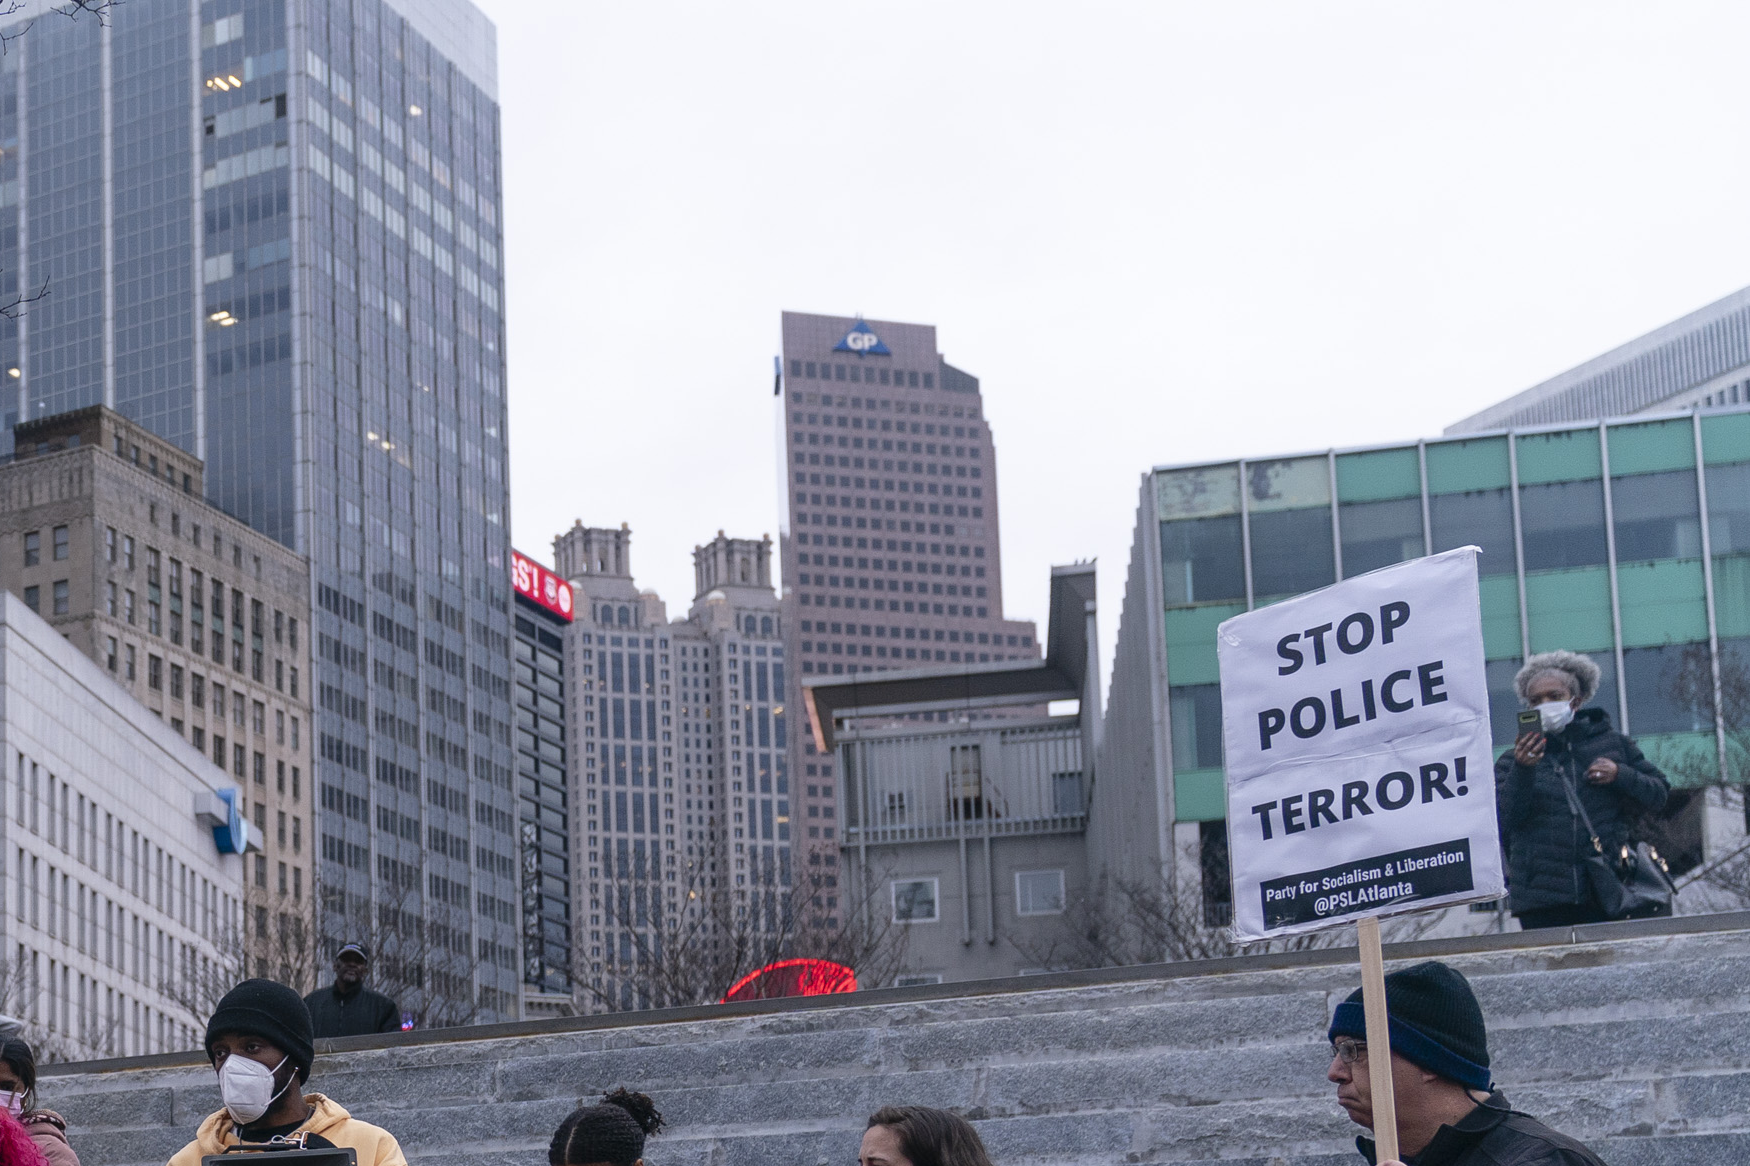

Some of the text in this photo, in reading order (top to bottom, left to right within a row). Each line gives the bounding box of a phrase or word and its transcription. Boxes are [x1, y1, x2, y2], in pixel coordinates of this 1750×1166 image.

[846, 331, 878, 351] GP
[1276, 601, 1410, 676] STOP
[1258, 660, 1448, 751] POLICE
[1252, 756, 1469, 841] TERROR!
[1266, 849, 1464, 902] Party for Socialism & Liberation
[1314, 881, 1413, 916] @PSLAtlanta
